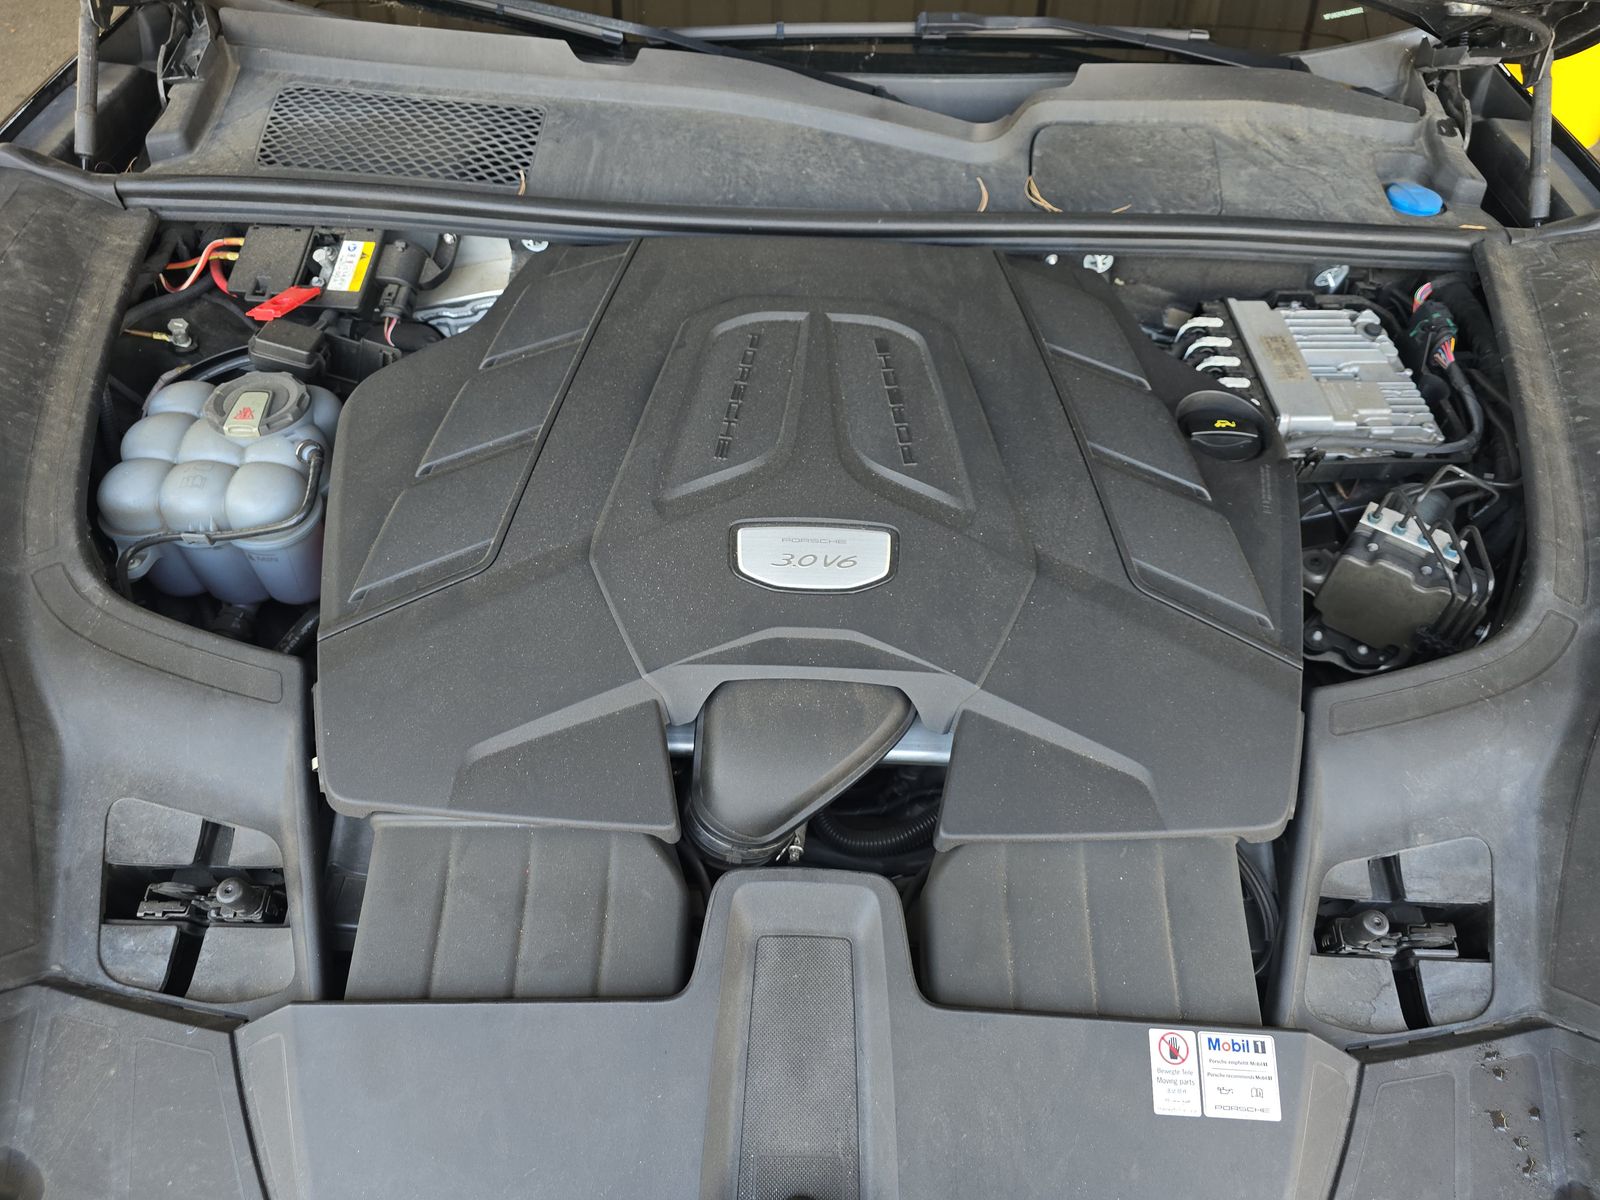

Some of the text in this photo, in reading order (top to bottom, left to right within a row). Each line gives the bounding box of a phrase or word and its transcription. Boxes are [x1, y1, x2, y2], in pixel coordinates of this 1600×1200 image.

[713, 333, 760, 460] PORSCHE
[874, 338, 918, 465] PORSCHE
[771, 553, 858, 568] 3.0 V6
[1207, 1037, 1266, 1054] Mobil 1
[1156, 1077, 1178, 1086] Moving
[1214, 1104, 1270, 1113] PORSCHE
